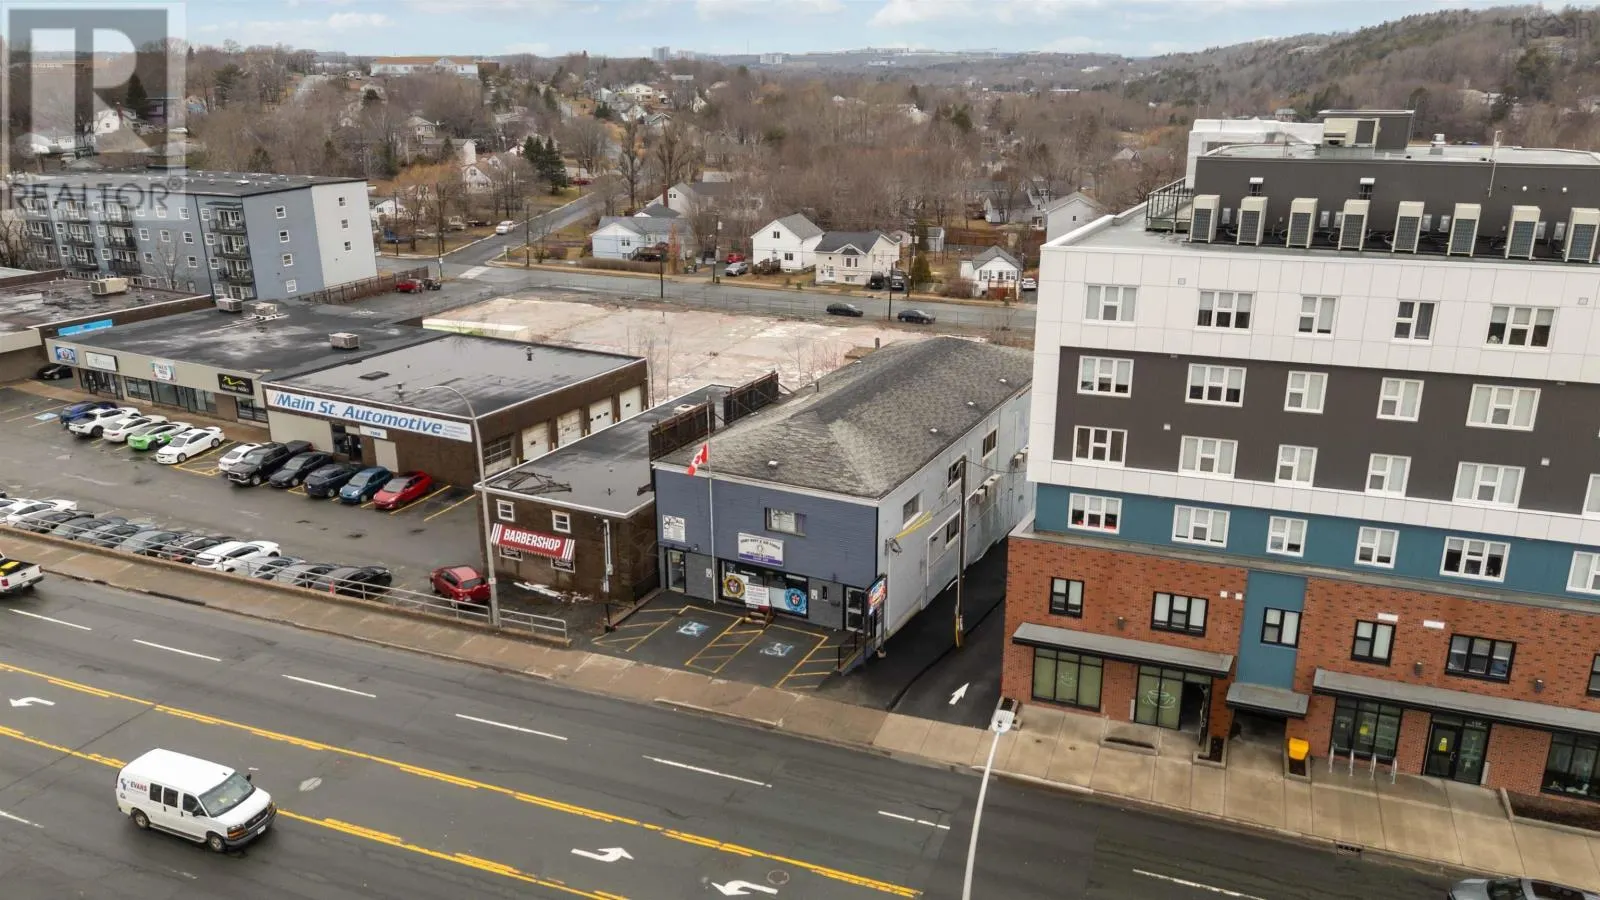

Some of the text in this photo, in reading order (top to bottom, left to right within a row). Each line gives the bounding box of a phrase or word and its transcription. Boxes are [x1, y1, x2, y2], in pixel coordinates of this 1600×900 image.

[276, 394, 315, 411] Main
[318, 401, 338, 416] St.
[343, 406, 442, 433] Automotive
[503, 528, 561, 551] BARBERSHOP
